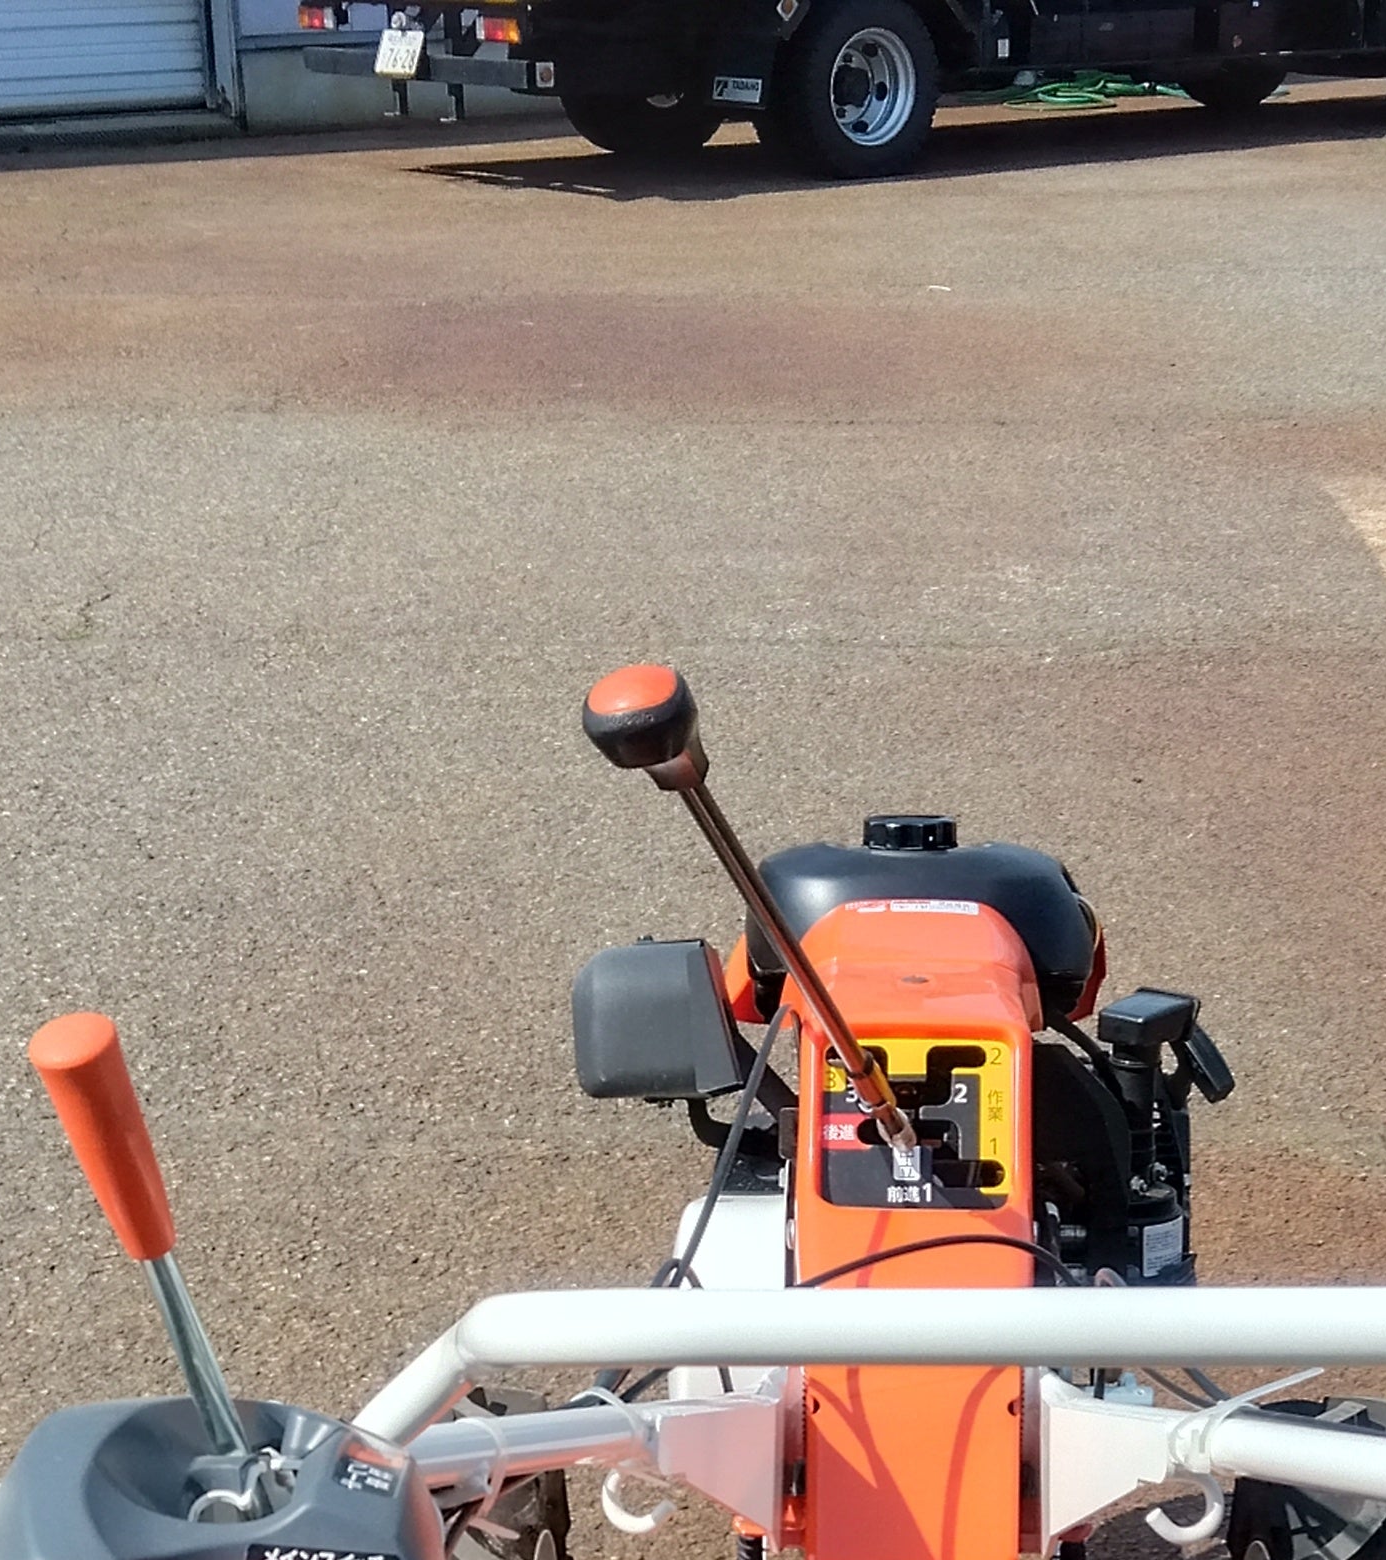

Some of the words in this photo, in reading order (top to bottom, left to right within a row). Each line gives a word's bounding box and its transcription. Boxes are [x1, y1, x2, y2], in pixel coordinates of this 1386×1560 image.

[989, 1047, 1003, 1066] 2
[953, 1083, 968, 1104] 2
[987, 1089, 1004, 1123] 作業
[823, 1123, 856, 1142] 後進
